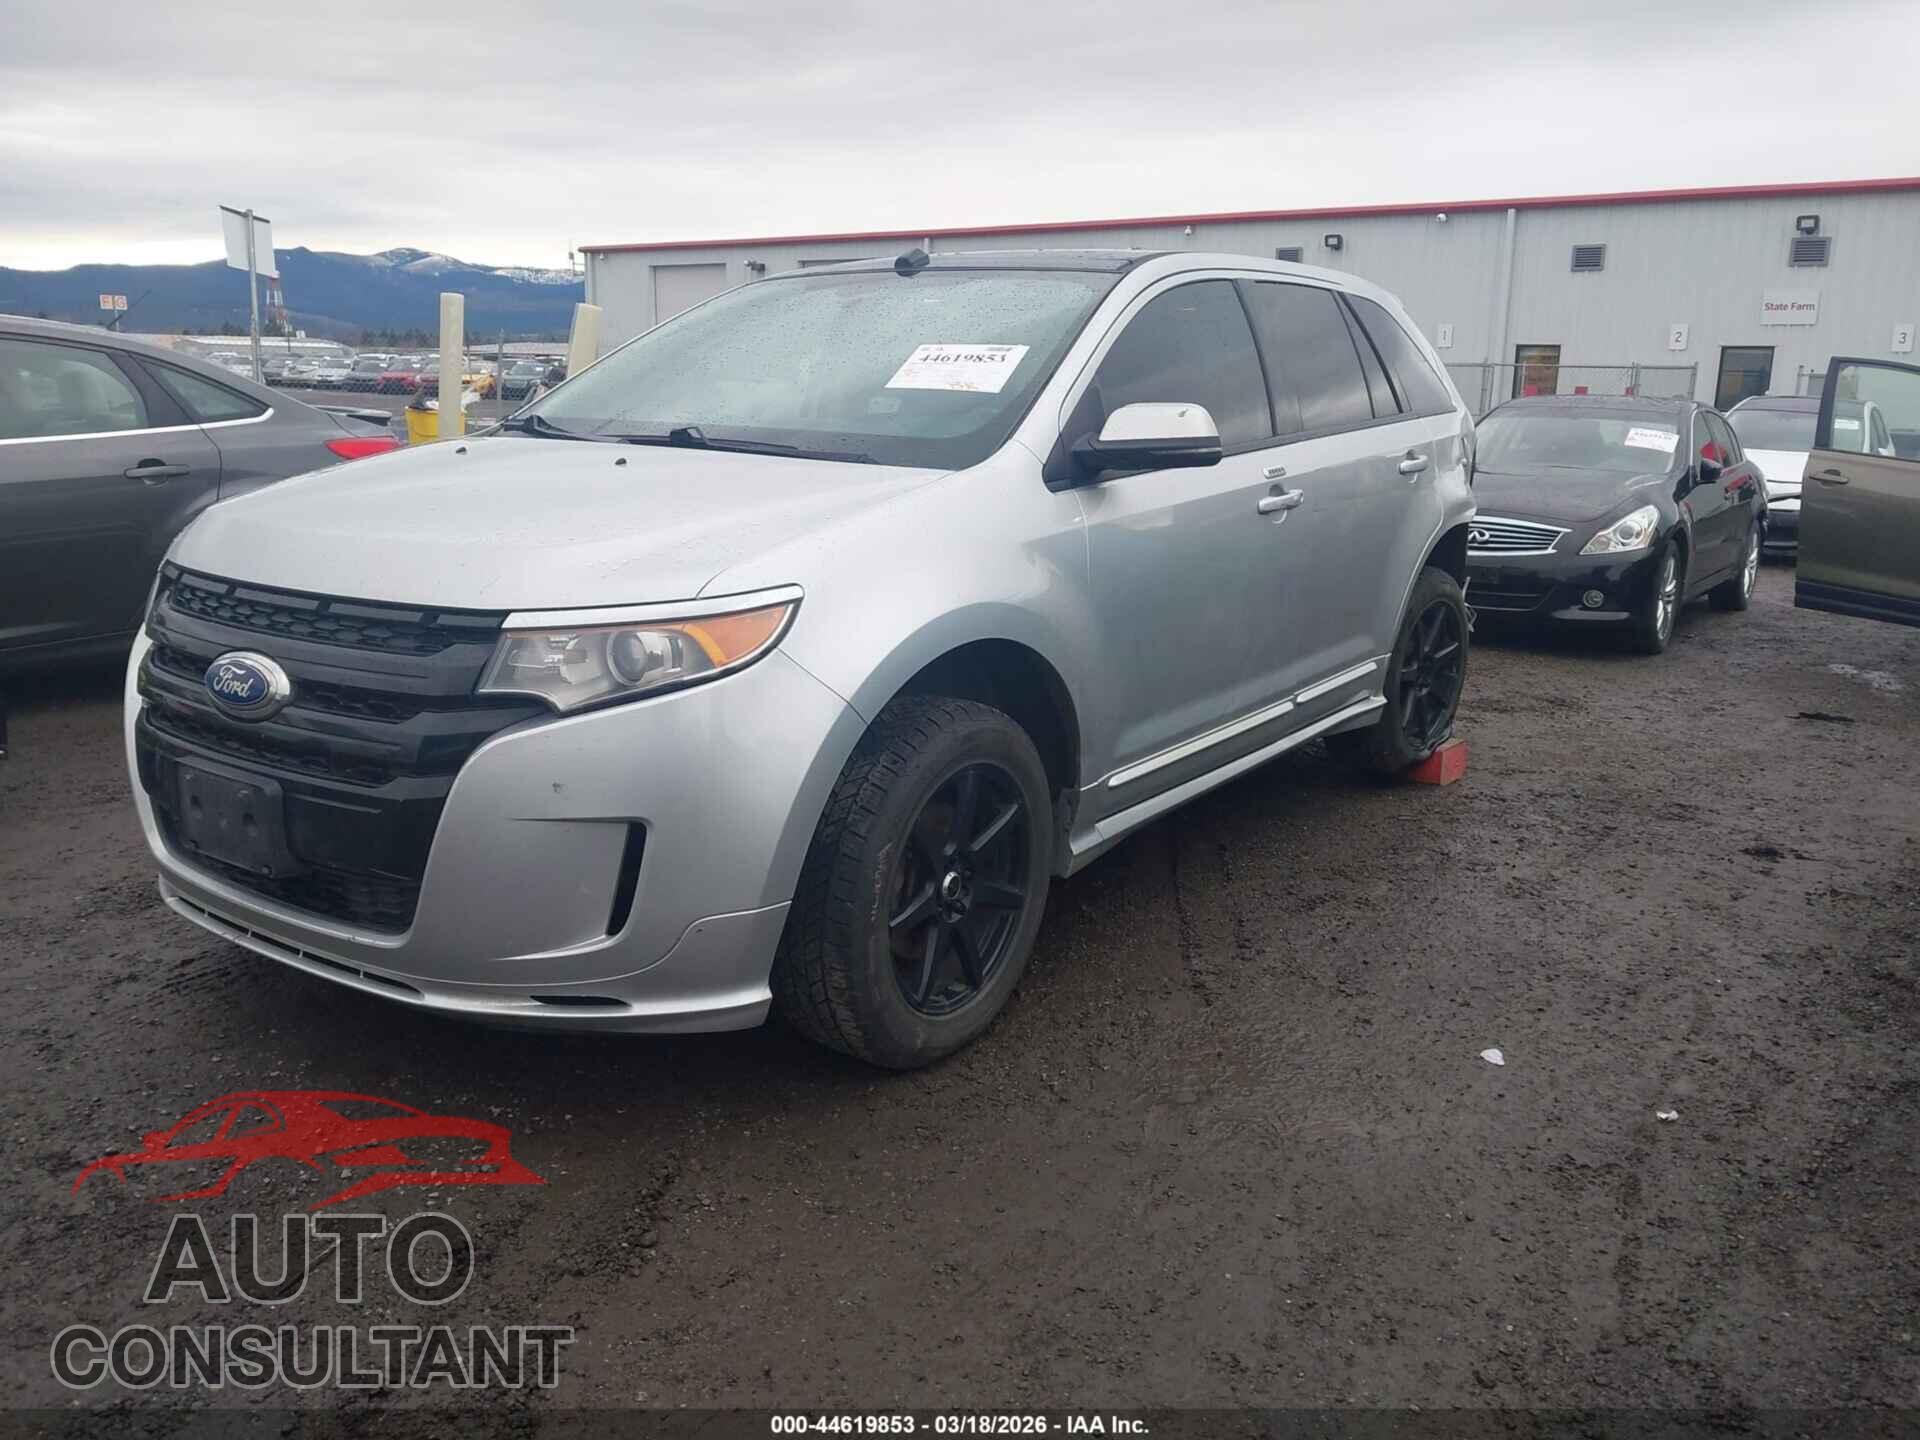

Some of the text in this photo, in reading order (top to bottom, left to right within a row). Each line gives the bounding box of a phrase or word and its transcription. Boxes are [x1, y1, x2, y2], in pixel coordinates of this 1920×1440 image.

[1764, 302, 1816, 311] State Farm
[1674, 331, 1682, 342] 2
[1898, 332, 1907, 344] 3
[213, 664, 254, 698] Ford
